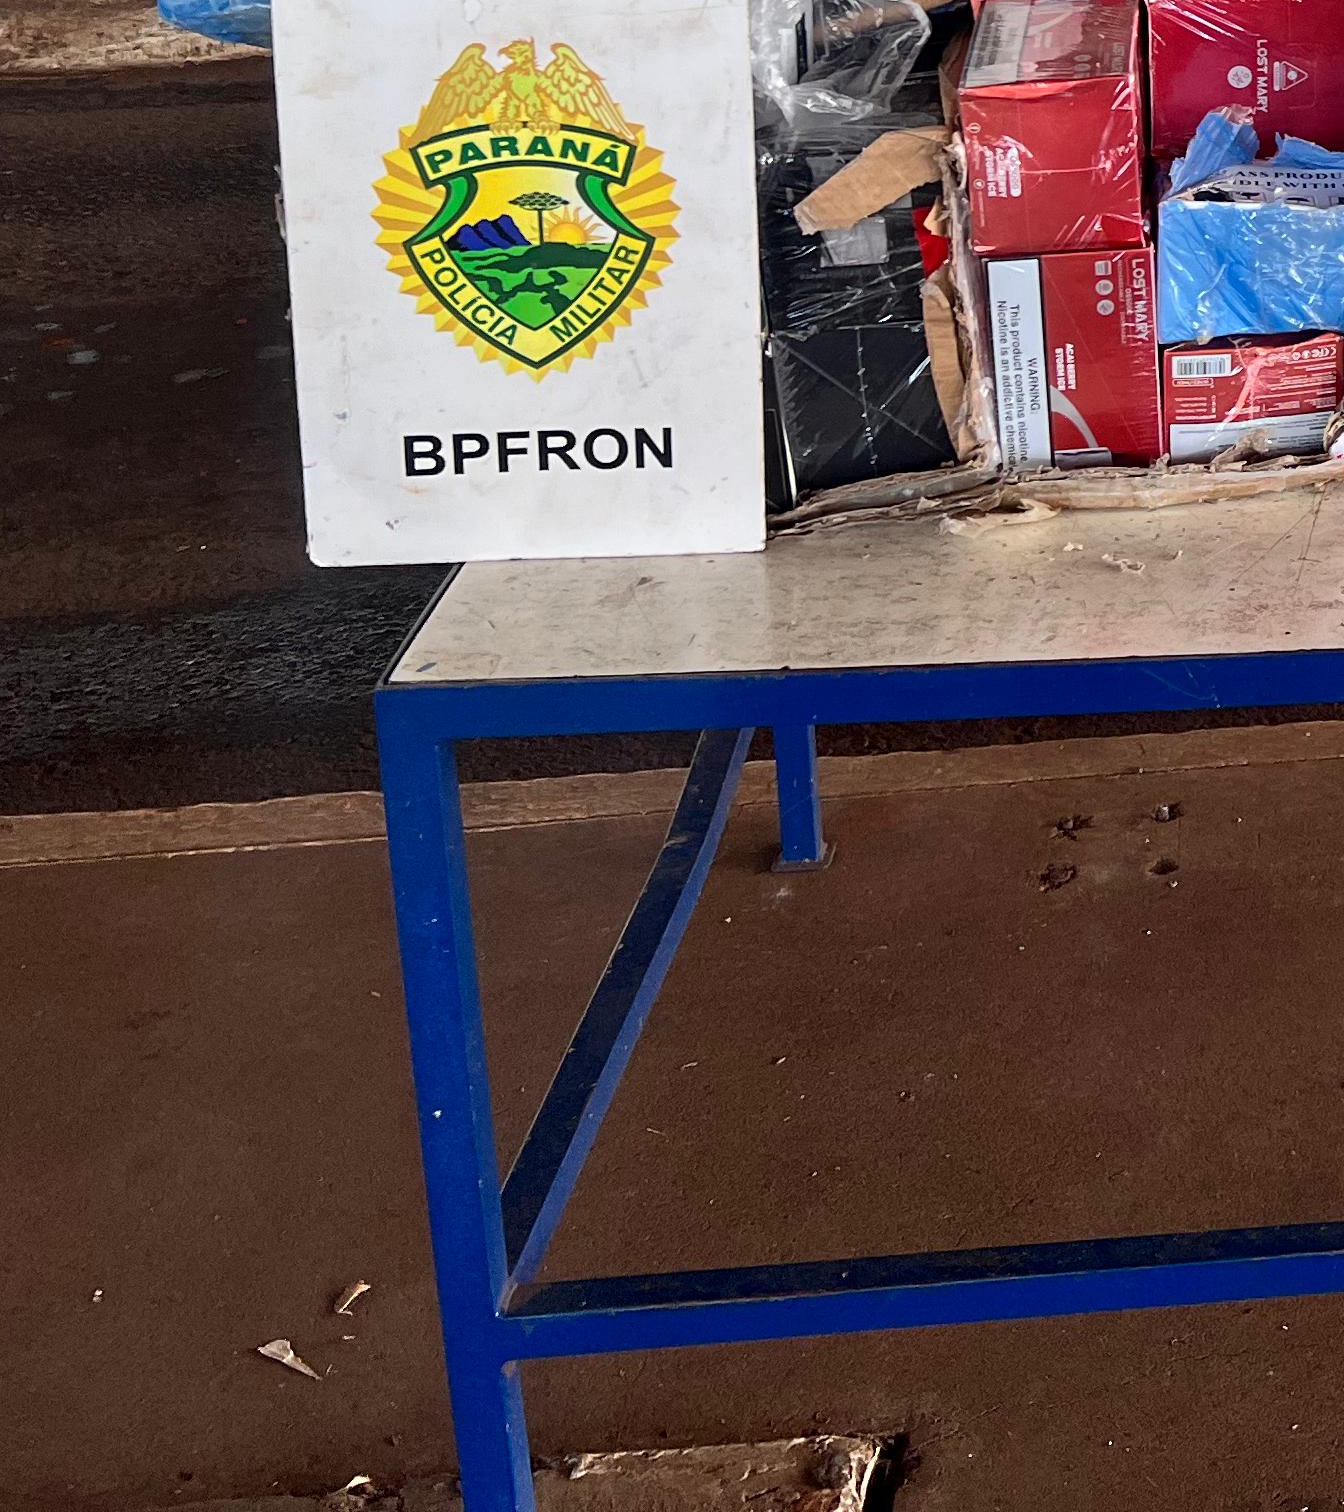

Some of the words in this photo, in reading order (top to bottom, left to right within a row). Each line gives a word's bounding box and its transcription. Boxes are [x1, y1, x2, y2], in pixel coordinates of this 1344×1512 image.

[1257, 39, 1268, 75] LOST
[1256, 78, 1268, 113] MARY
[424, 134, 622, 176] PARANÁ
[1283, 180, 1336, 188] WITH
[550, 245, 640, 343] MILITAR
[1132, 258, 1146, 296] LOST
[997, 301, 1007, 344] Nicotine
[1010, 304, 1020, 327] This
[1134, 301, 1148, 340] MARY
[1000, 347, 1009, 356] is
[1002, 360, 1009, 371] an
[1010, 330, 1023, 370] product
[1003, 374, 1013, 421] addictive
[1015, 374, 1025, 419] contains
[403, 426, 673, 477] BPFRON
